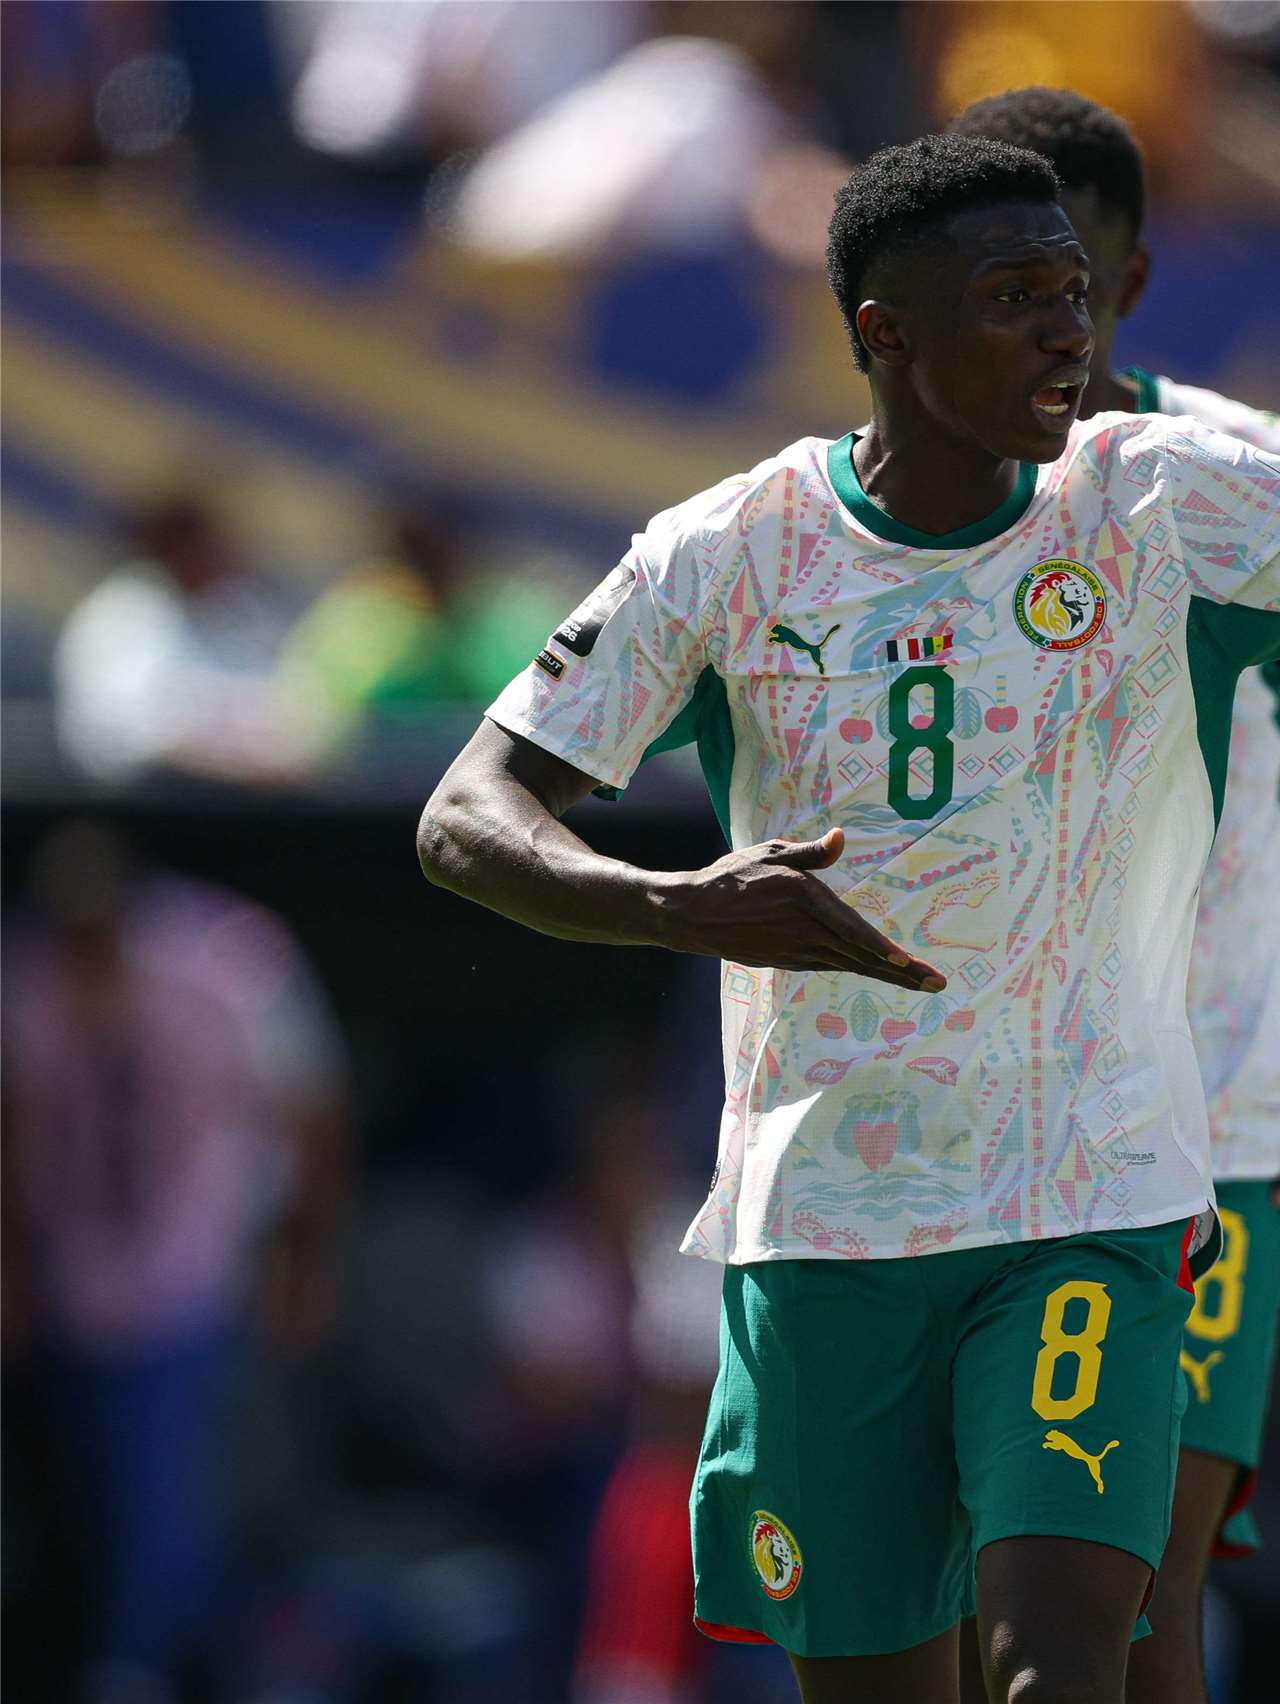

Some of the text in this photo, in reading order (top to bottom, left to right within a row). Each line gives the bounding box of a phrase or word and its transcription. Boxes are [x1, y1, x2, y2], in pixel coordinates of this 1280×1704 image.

[560, 626, 578, 642] 26
[888, 665, 954, 820] 8
[1185, 1206, 1250, 1342] 8
[1031, 1280, 1112, 1421] 8
